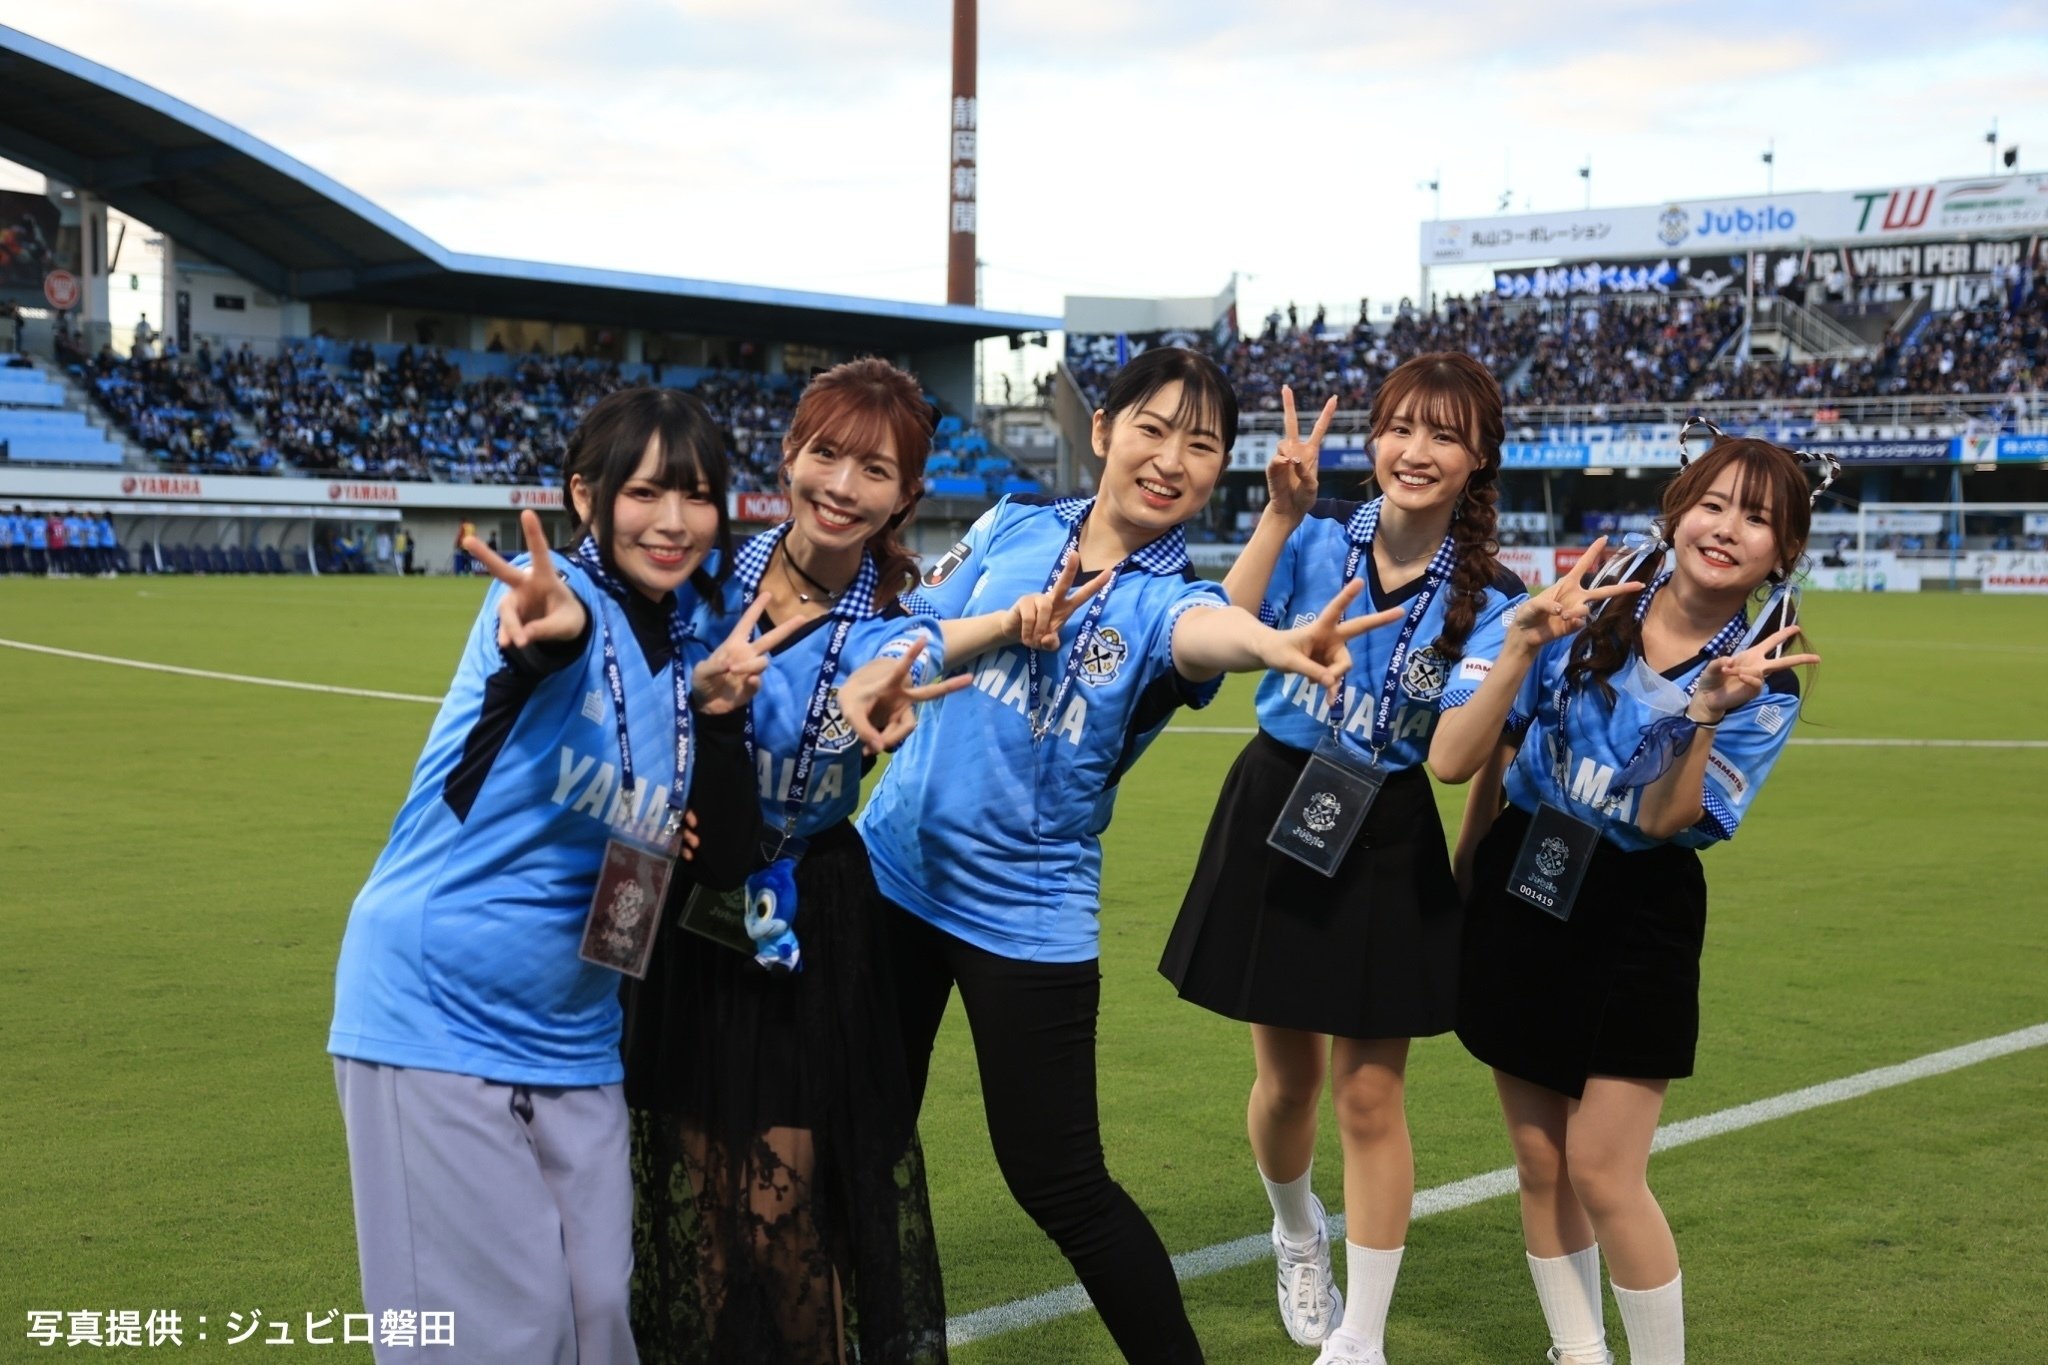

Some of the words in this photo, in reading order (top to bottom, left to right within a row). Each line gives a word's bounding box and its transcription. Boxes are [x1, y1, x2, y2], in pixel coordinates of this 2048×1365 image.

[1853, 187, 1936, 232] TW
[1923, 243, 1971, 275] PER
[139, 477, 201, 495] YAMAHA
[342, 484, 398, 501] YAMAHA
[972, 648, 1088, 746] MAHA
[551, 745, 669, 845] YAMA
[1519, 884, 1554, 907] 001419
